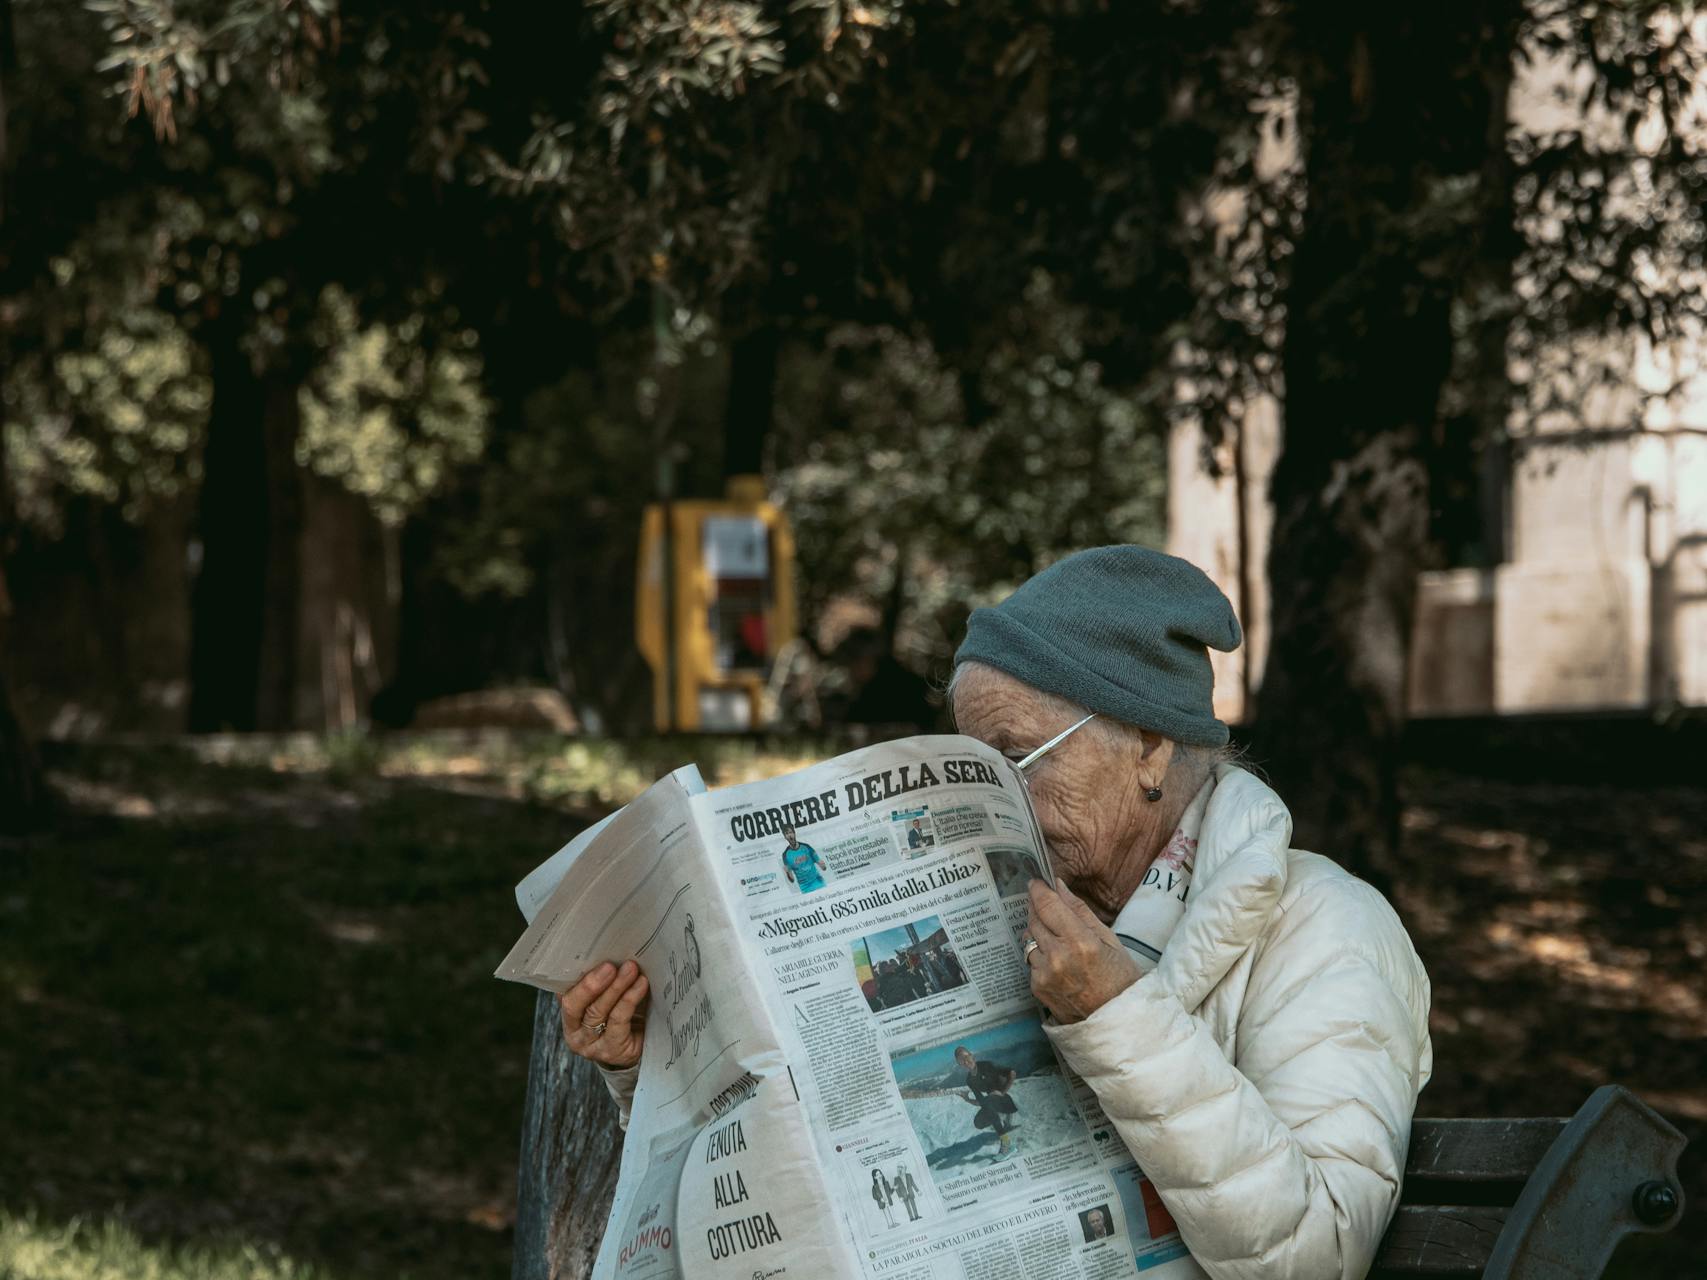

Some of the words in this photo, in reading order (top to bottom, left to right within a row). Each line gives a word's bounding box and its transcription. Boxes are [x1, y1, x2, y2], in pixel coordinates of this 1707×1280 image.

[731, 790, 840, 842] CORRIERE
[845, 762, 940, 812] DELLA
[943, 759, 1003, 788] SERA
[825, 849, 847, 861] Napoli
[847, 837, 888, 854] inarrestabile
[829, 858, 854, 870] Battuta
[853, 848, 886, 862] l'Atalanta
[758, 907, 831, 937] «Migranti,
[830, 898, 857, 918] 685
[859, 889, 892, 911] mila
[891, 878, 928, 900] dalla
[928, 863, 980, 888] Libia»
[963, 883, 987, 895] decreto
[774, 958, 813, 973] VARIABILE
[813, 949, 844, 963] GUERRA
[827, 961, 838, 970] PD
[706, 1119, 747, 1164] TENUTA
[714, 1169, 749, 1209] ALLA
[620, 1225, 671, 1271] RUMMO
[707, 1212, 782, 1261] COTTURA
[872, 1262, 883, 1271] LA
[884, 1247, 928, 1267] PARABOLA
[929, 1234, 964, 1253] (SOCIAL)
[965, 1229, 980, 1240] DEL
[982, 1221, 1008, 1234] RICCO
[1015, 1215, 1021, 1224] IL
[1023, 1204, 1057, 1221] POVERO
